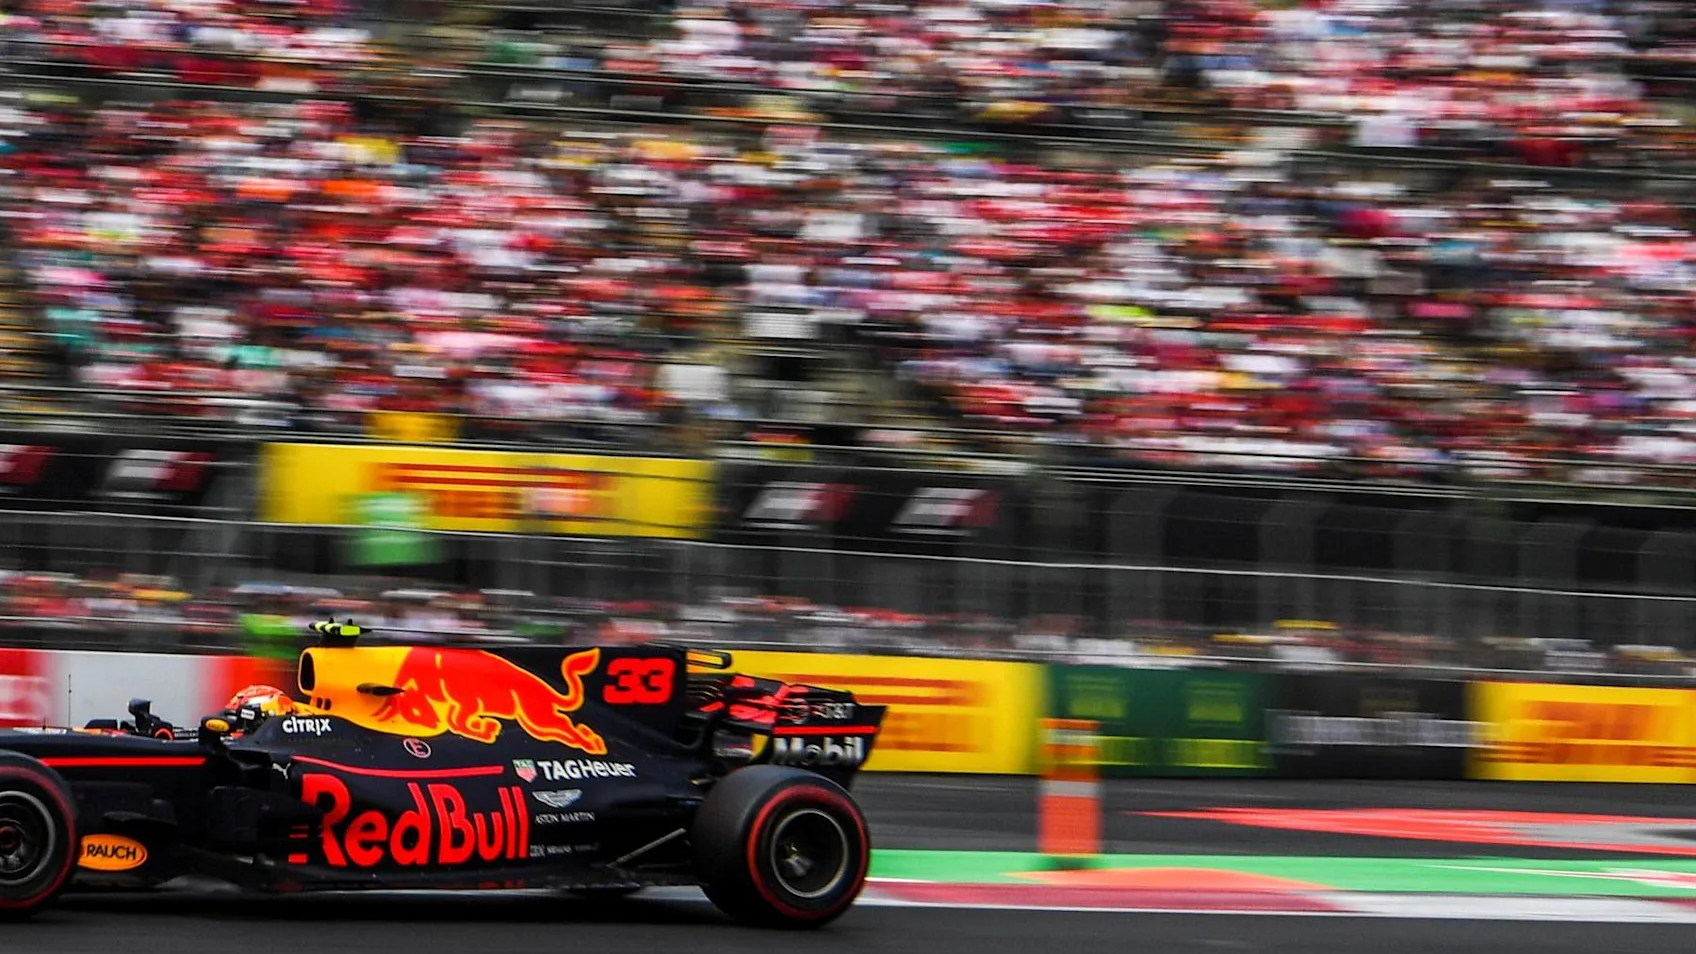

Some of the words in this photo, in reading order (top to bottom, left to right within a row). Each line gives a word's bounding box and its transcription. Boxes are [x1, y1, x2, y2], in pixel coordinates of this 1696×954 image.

[603, 657, 676, 704] 33
[772, 736, 865, 766] Mobil
[87, 844, 137, 860] RAUCH
